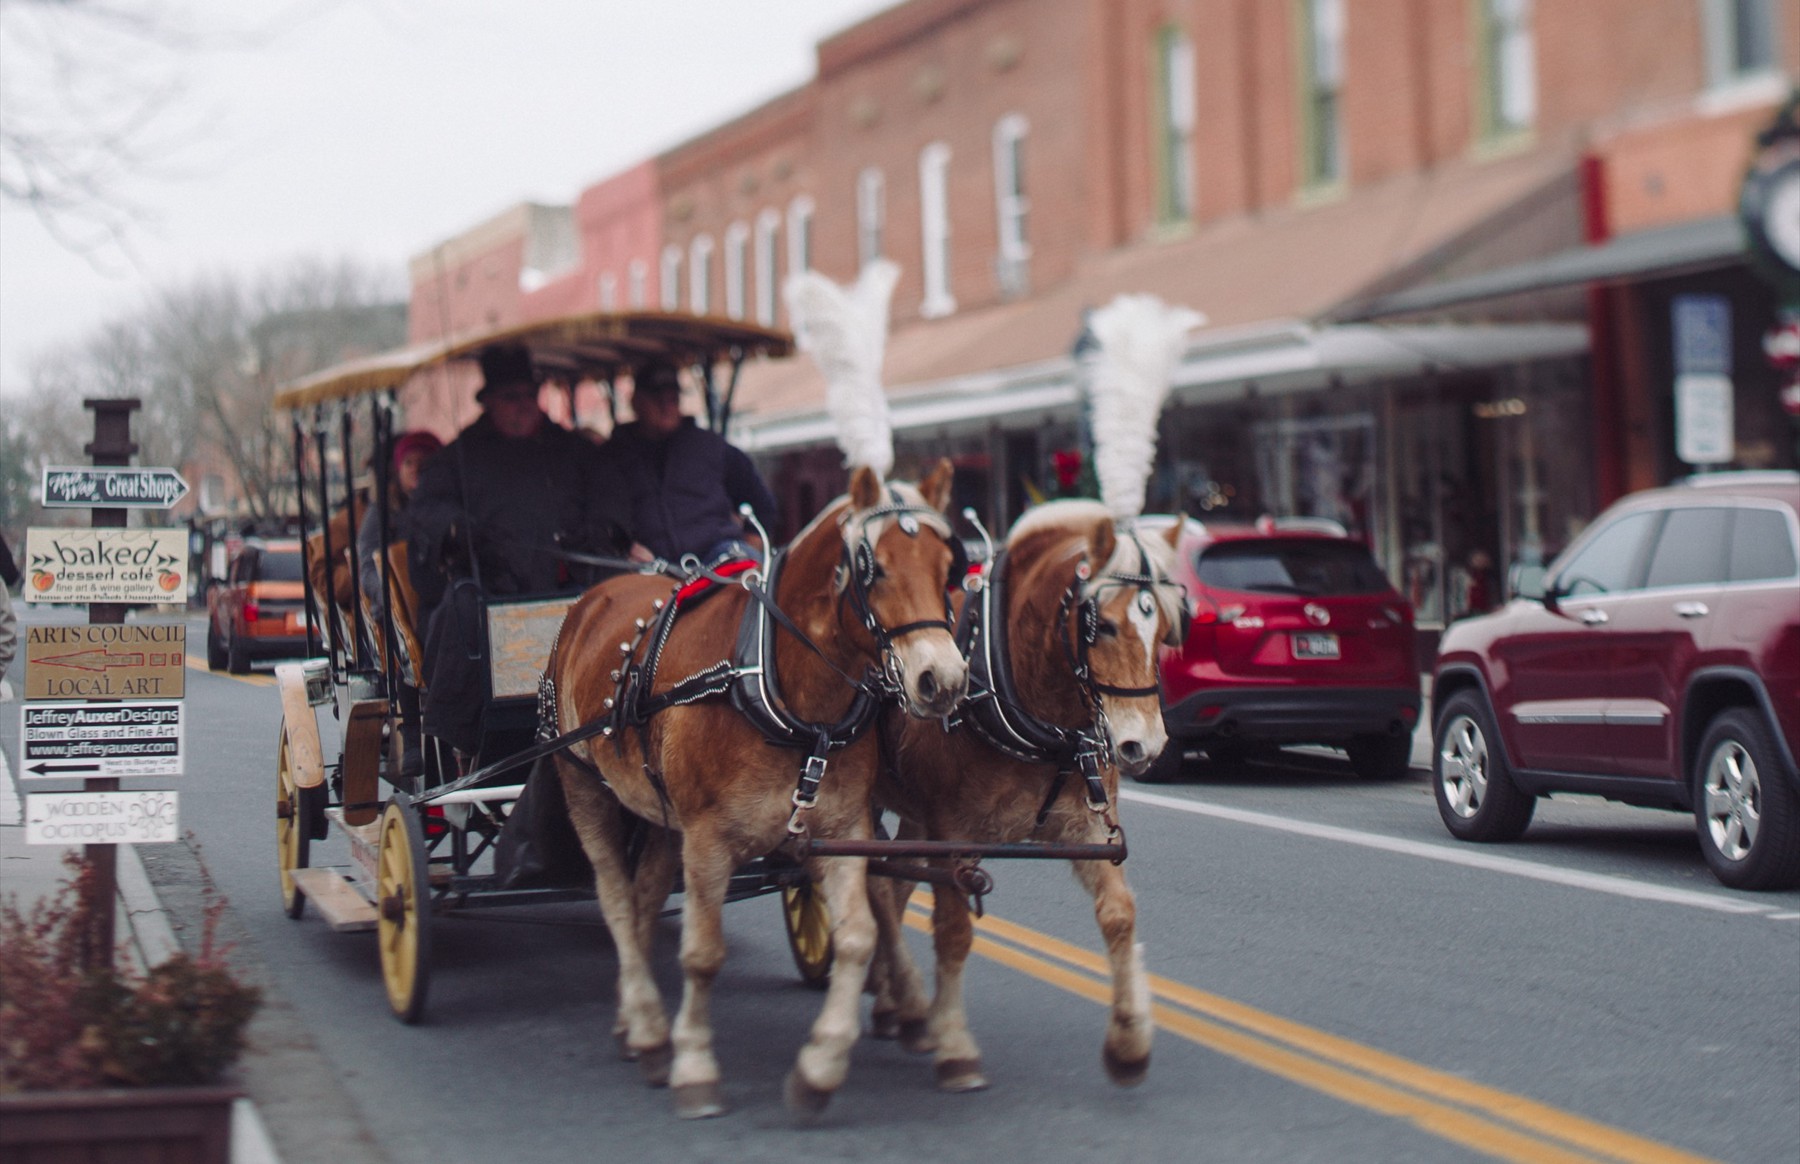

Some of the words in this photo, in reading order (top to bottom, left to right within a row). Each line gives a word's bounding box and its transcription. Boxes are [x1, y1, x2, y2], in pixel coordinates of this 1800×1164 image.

[105, 472, 139, 498] Great
[139, 471, 179, 507] Shops
[53, 540, 159, 566] baked
[56, 567, 114, 581] dessert
[120, 567, 153, 581] café
[56, 584, 73, 592] fine
[75, 584, 88, 592] art
[90, 584, 97, 592] &
[100, 584, 121, 592] wine
[123, 584, 154, 593] gallery
[28, 627, 81, 644] ARTS
[87, 626, 185, 643] COUNCIL
[47, 679, 115, 696] LOCAL
[121, 677, 163, 695] ART
[26, 708, 178, 726] JeffreyAuxerDesigns
[27, 729, 64, 740] Blown
[67, 728, 99, 739] Glass
[102, 727, 124, 737] and
[128, 726, 153, 737] Fine
[156, 725, 175, 736] Art
[29, 741, 176, 757] www.jeffreyauxer.com
[46, 801, 123, 818] WOODEN
[41, 823, 127, 839] OCTOPUS
